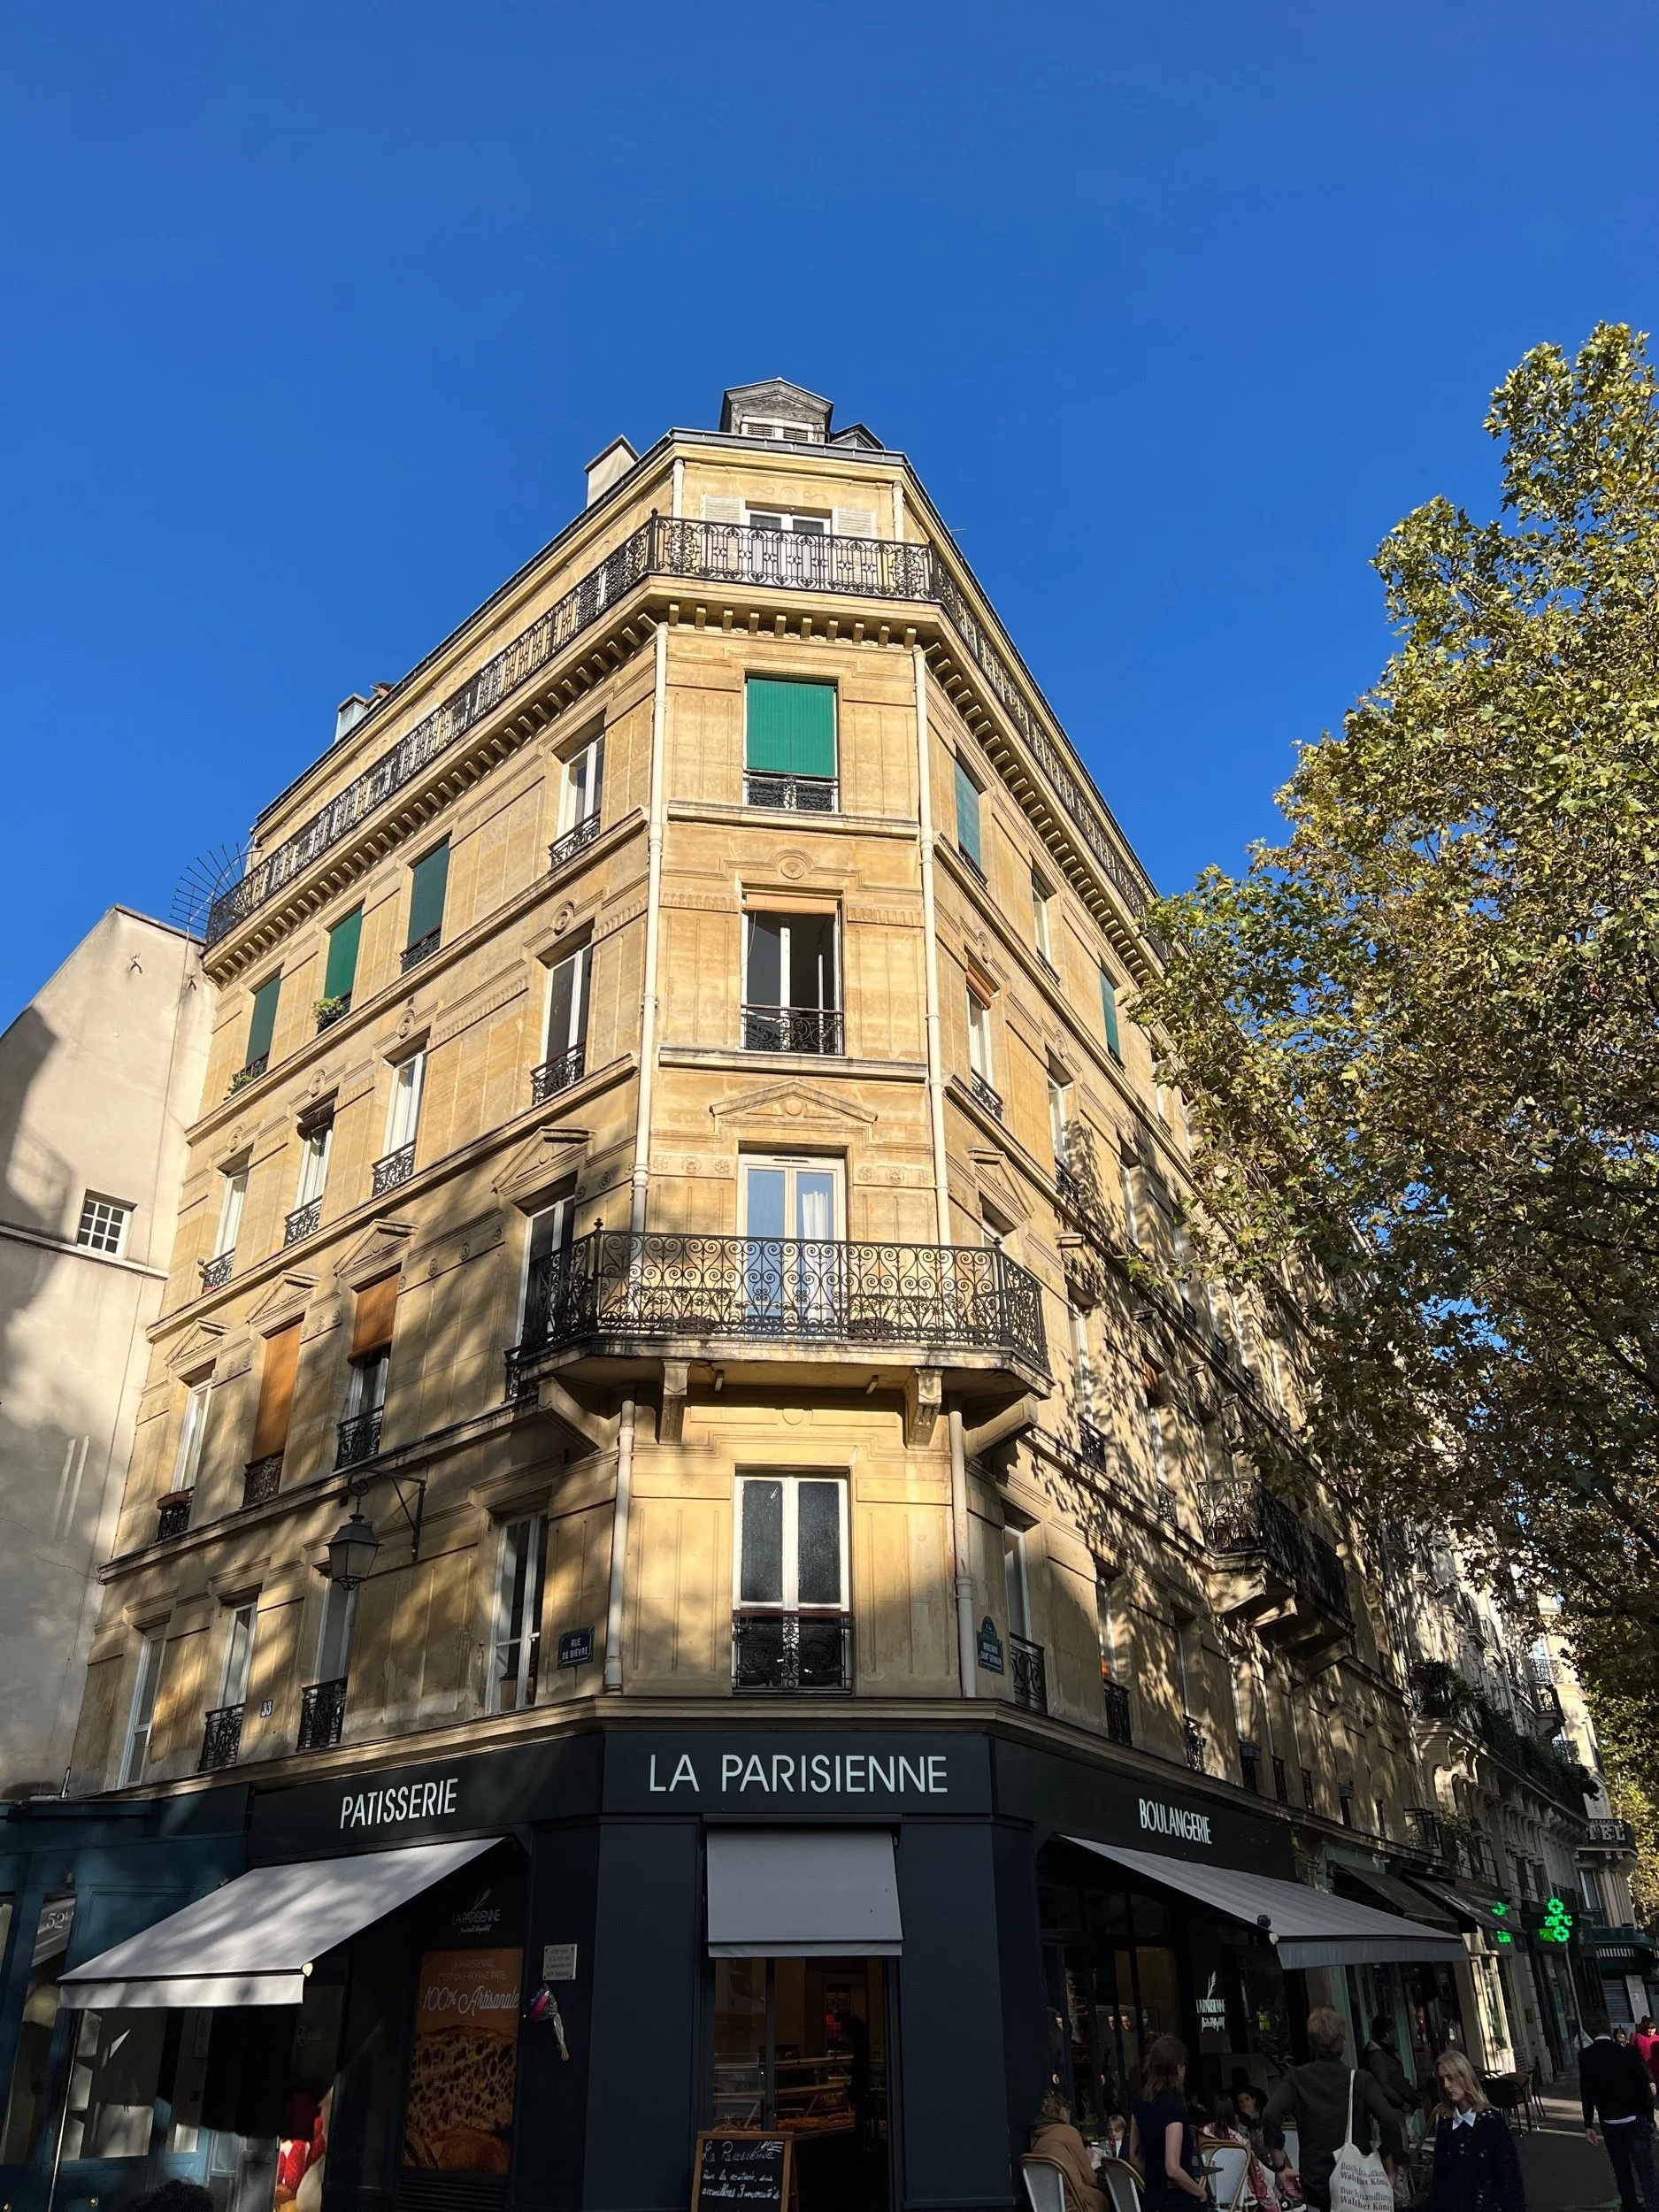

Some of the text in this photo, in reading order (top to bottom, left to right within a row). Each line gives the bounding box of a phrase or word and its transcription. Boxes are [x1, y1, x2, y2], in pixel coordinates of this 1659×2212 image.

[571, 1637, 581, 1647] RUE
[562, 1650, 569, 1660] DE
[261, 1701, 273, 1717] 33
[649, 1754, 949, 1793] LA PARISIENNE
[340, 1778, 458, 1830] PATISSERIE
[1139, 1798, 1213, 1845] BOULANGERIE
[423, 1985, 458, 2012] 100%
[1340, 2195, 1371, 2210] Walther
